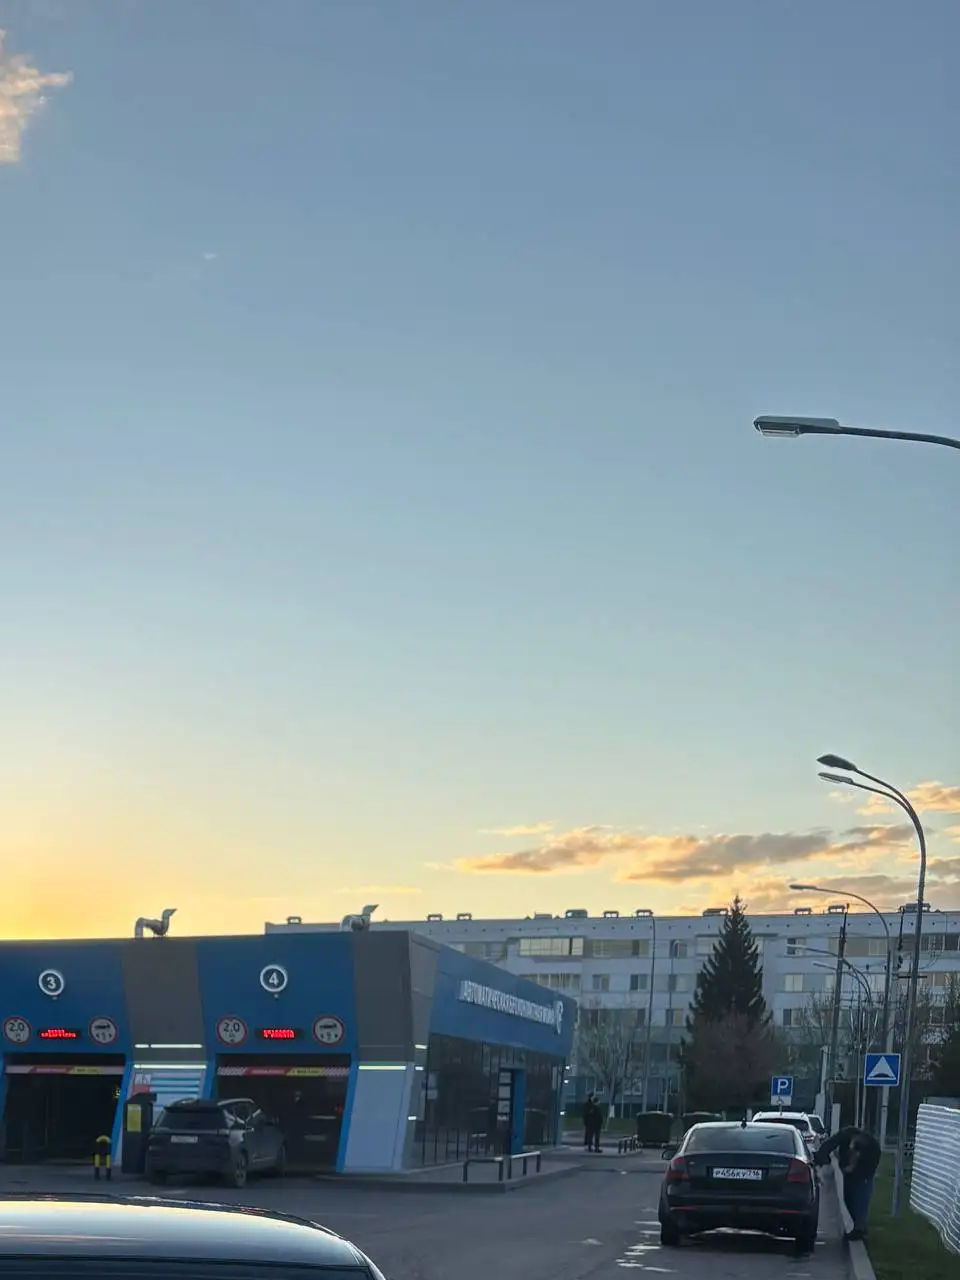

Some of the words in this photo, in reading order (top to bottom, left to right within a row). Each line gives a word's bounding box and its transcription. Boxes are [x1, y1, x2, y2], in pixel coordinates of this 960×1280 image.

[47, 976, 57, 989] 3
[268, 972, 279, 985] 4
[8, 1022, 25, 1032] 2.0
[223, 1022, 240, 1033] 2.0
[777, 1078, 789, 1093] P
